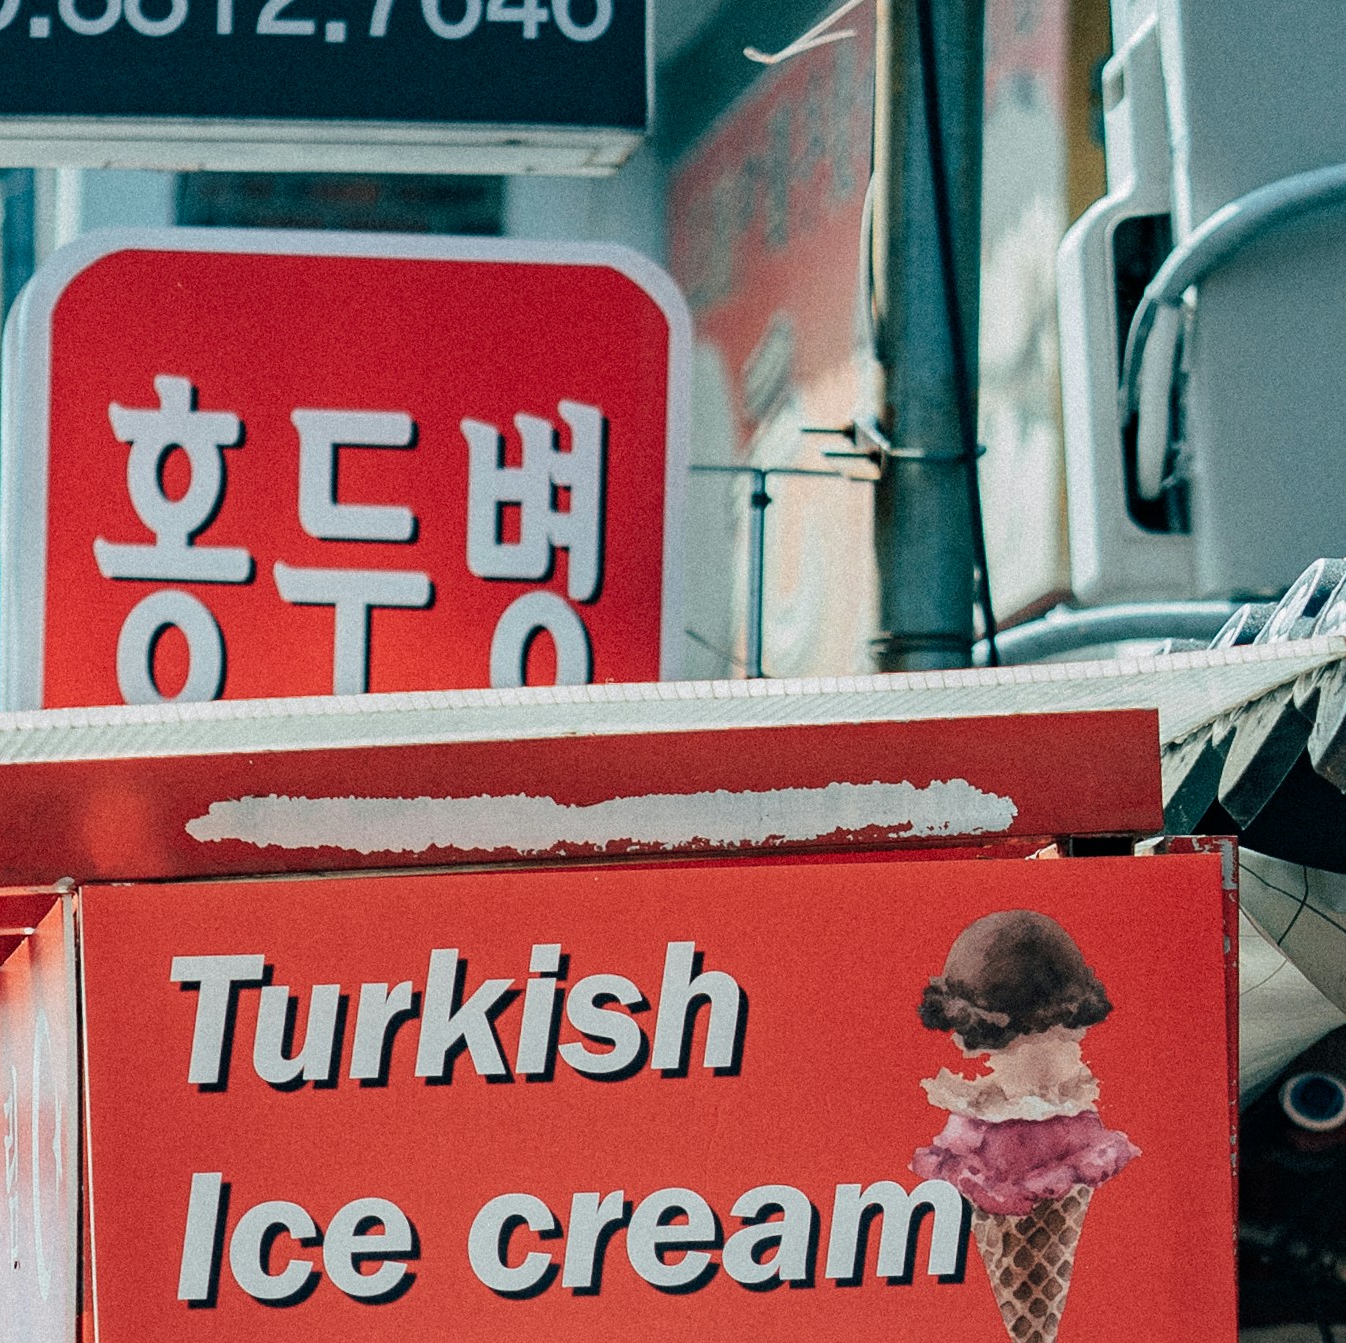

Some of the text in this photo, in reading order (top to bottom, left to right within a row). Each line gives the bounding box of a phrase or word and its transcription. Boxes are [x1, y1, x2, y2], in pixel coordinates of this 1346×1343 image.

[92, 374, 606, 704] 홍두병
[168, 940, 744, 1088] Turkish
[177, 1172, 974, 1307] Ice cream
